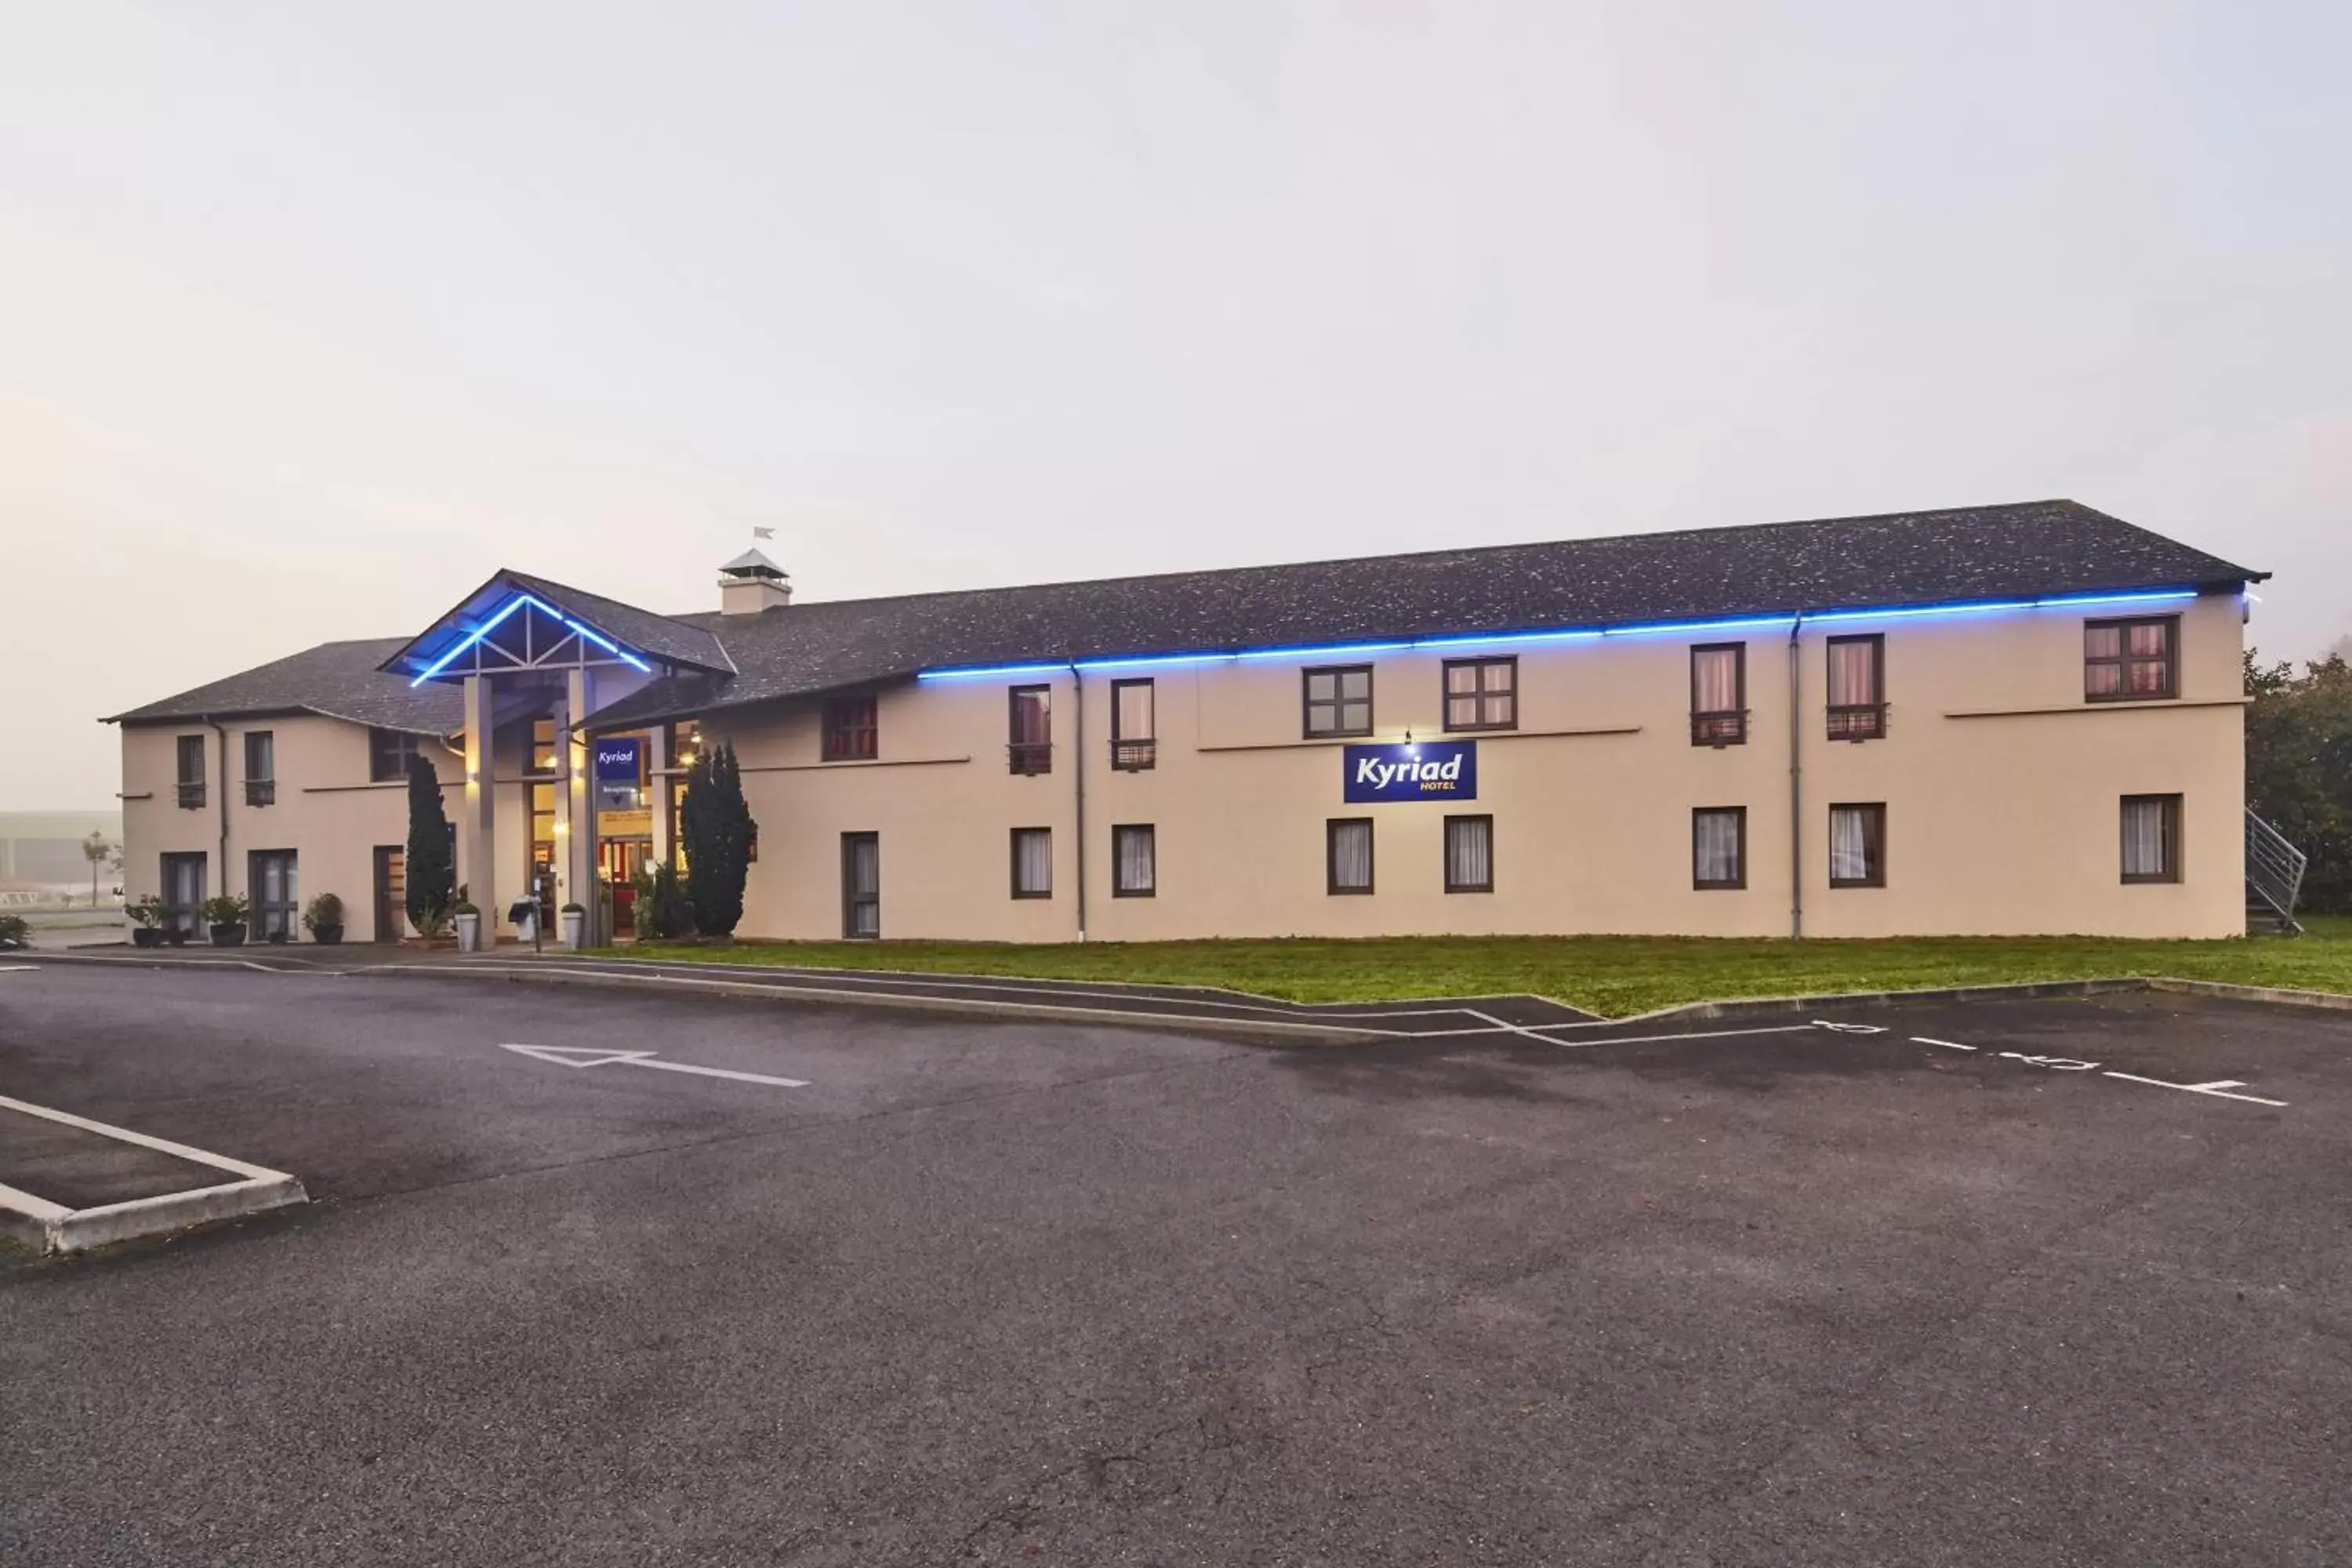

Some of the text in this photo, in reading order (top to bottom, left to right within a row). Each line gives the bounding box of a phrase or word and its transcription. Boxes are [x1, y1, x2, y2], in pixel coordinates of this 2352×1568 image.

[599, 750, 633, 764] Kyriad
[1356, 754, 1463, 789] Kyriad
[1420, 782, 1456, 790] HOTEL
